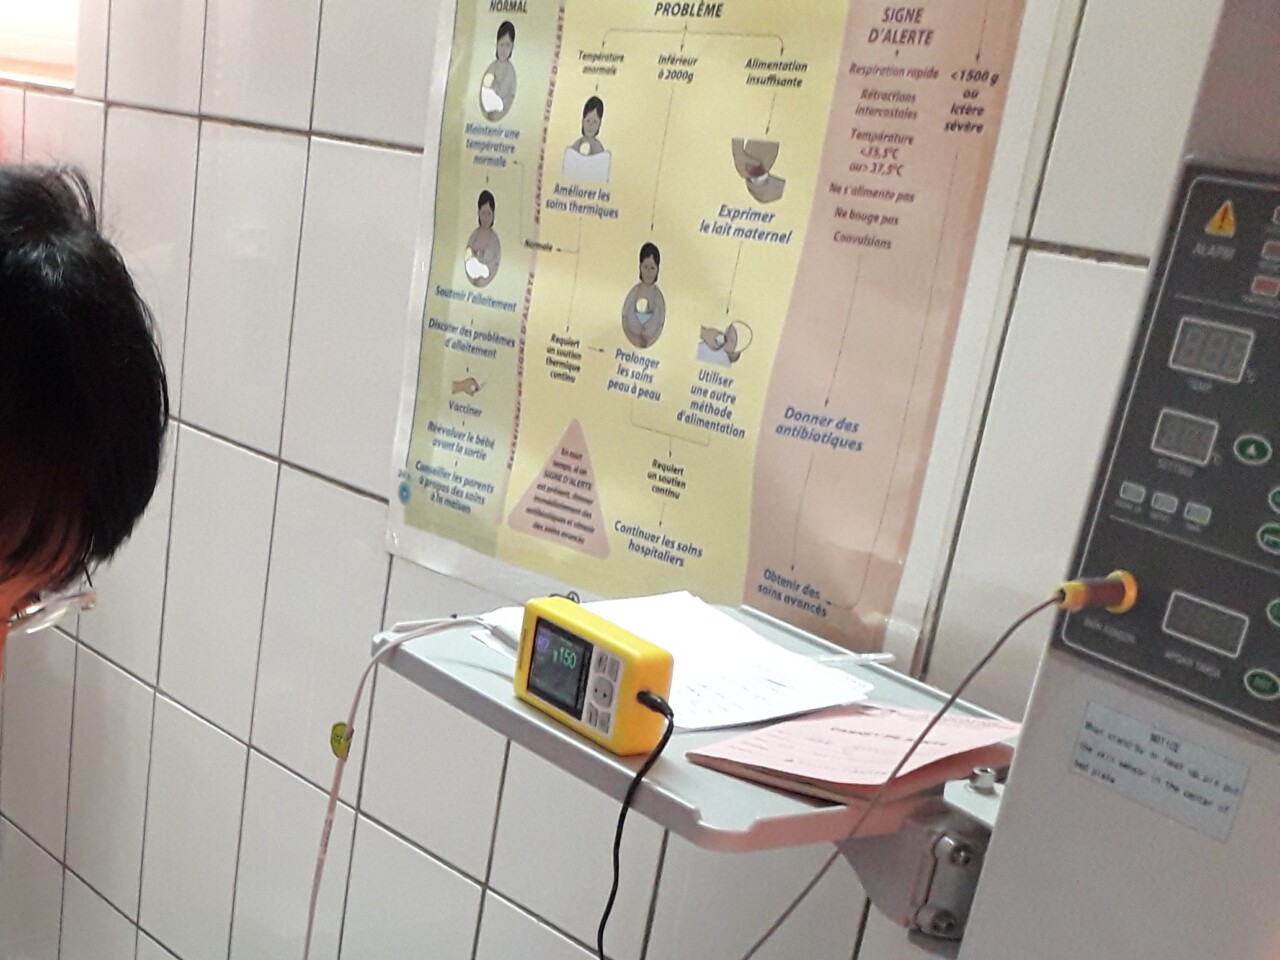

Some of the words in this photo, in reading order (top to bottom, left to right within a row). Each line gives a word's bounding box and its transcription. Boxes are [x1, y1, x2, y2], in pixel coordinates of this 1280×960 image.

[489, 0, 528, 13] NORMAL
[654, 2, 723, 18] PROBLÈME
[882, 7, 924, 23] SIGNE
[868, 29, 934, 45] D'ALERTE
[578, 50, 624, 63] Température
[657, 54, 698, 67] Inférieur
[745, 58, 808, 72] Alimentation
[582, 65, 617, 76] anormale
[657, 69, 665, 80] à
[665, 70, 694, 84] 2000g
[848, 62, 905, 78] Respiration
[906, 66, 939, 80] rapide
[746, 75, 803, 88] insuffisante
[860, 89, 916, 102] Rétractions
[963, 89, 979, 99] ou
[504, 127, 520, 140] une
[944, 119, 983, 134] sévère
[851, 128, 914, 145] Température
[553, 183, 597, 200] Améliorer
[599, 188, 611, 202] les
[895, 191, 915, 203] pas
[545, 200, 567, 212] soins
[569, 202, 619, 220] thermiques
[718, 204, 776, 224] Exprimer
[834, 206, 847, 219] Ne
[848, 209, 879, 225] bouge
[880, 215, 899, 226] pas
[699, 219, 711, 233] le
[711, 220, 730, 236] lait
[732, 227, 792, 245] maternel
[833, 231, 892, 249] Convulsions
[459, 325, 472, 338] des
[615, 348, 660, 370] Prolonger
[617, 362, 628, 376] les
[629, 369, 653, 384] soins
[699, 369, 734, 388] Utiliser
[607, 379, 629, 394] peau
[637, 387, 661, 401] peau
[690, 385, 708, 398] une
[710, 390, 736, 405] autre
[449, 400, 482, 418] Vacciner
[690, 401, 732, 420] méthode
[676, 411, 745, 438] d'alimentation
[784, 406, 833, 427] Donner
[835, 417, 859, 433] des
[775, 424, 863, 451] antibiotiques
[652, 459, 684, 475] Requiert
[648, 471, 657, 480] un
[658, 473, 686, 489] soutien
[652, 485, 680, 499] continu
[614, 520, 661, 543] Continuer
[662, 535, 675, 549] les
[677, 540, 702, 558] soins
[629, 539, 685, 566] hospitaliers
[764, 568, 801, 591] Obtenir
[802, 584, 820, 600] des
[758, 583, 782, 600] soins
[784, 592, 827, 617] avancés
